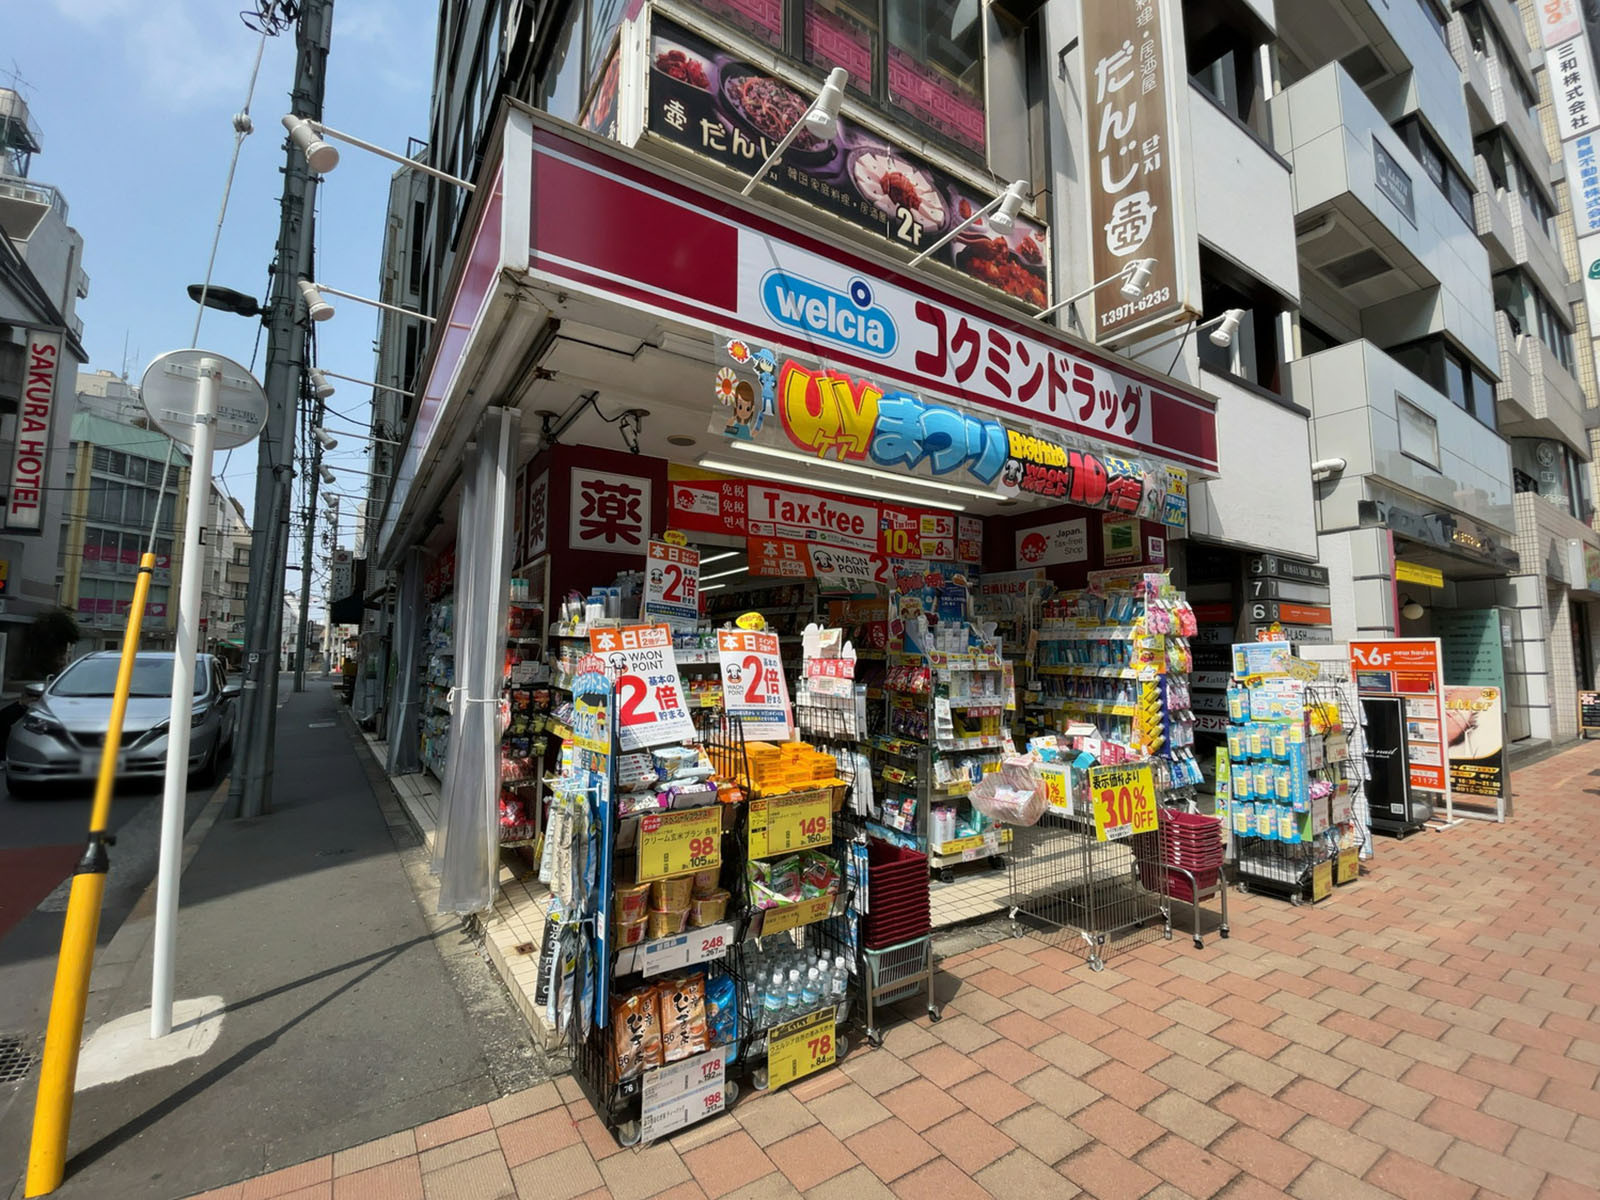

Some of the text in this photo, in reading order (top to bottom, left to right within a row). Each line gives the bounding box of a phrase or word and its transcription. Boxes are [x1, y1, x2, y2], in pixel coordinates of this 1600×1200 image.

[1557, 42, 1588, 129] 三和株式会社
[1141, 134, 1161, 175] 단지
[896, 207, 923, 246] 2F
[775, 281, 885, 350] welcia
[914, 300, 1144, 436] コクミンドラッグ
[11, 343, 57, 515] SAKURA HOTEL
[1025, 463, 1069, 483] WAON
[579, 479, 642, 545] 薬
[763, 491, 865, 535] Tax-free
[652, 545, 679, 561] 本日
[762, 540, 797, 559] 本日
[832, 554, 869, 566] WAON
[869, 553, 889, 584] 2
[838, 565, 870, 576] POINT
[662, 564, 683, 602] 2
[682, 576, 697, 597] 倍
[1253, 581, 1263, 596] 7
[1253, 604, 1265, 619] 6
[595, 630, 639, 651] 本日
[722, 634, 757, 650] 本日
[628, 650, 663, 661] WAON
[1368, 647, 1391, 667] 6F
[632, 660, 664, 672] POINT
[648, 674, 675, 686] 基本の
[742, 655, 766, 704] 2
[764, 668, 780, 695] 倍
[615, 675, 658, 727] 2
[655, 685, 679, 710] 倍
[1092, 770, 1140, 790] 表示価格より
[799, 816, 827, 836] 149
[1134, 810, 1154, 829] OFF
[689, 836, 714, 857] 98
[702, 936, 724, 951] 248
[808, 1034, 831, 1059] 78
[701, 1058, 721, 1075] 178
[703, 1091, 721, 1107] 198
